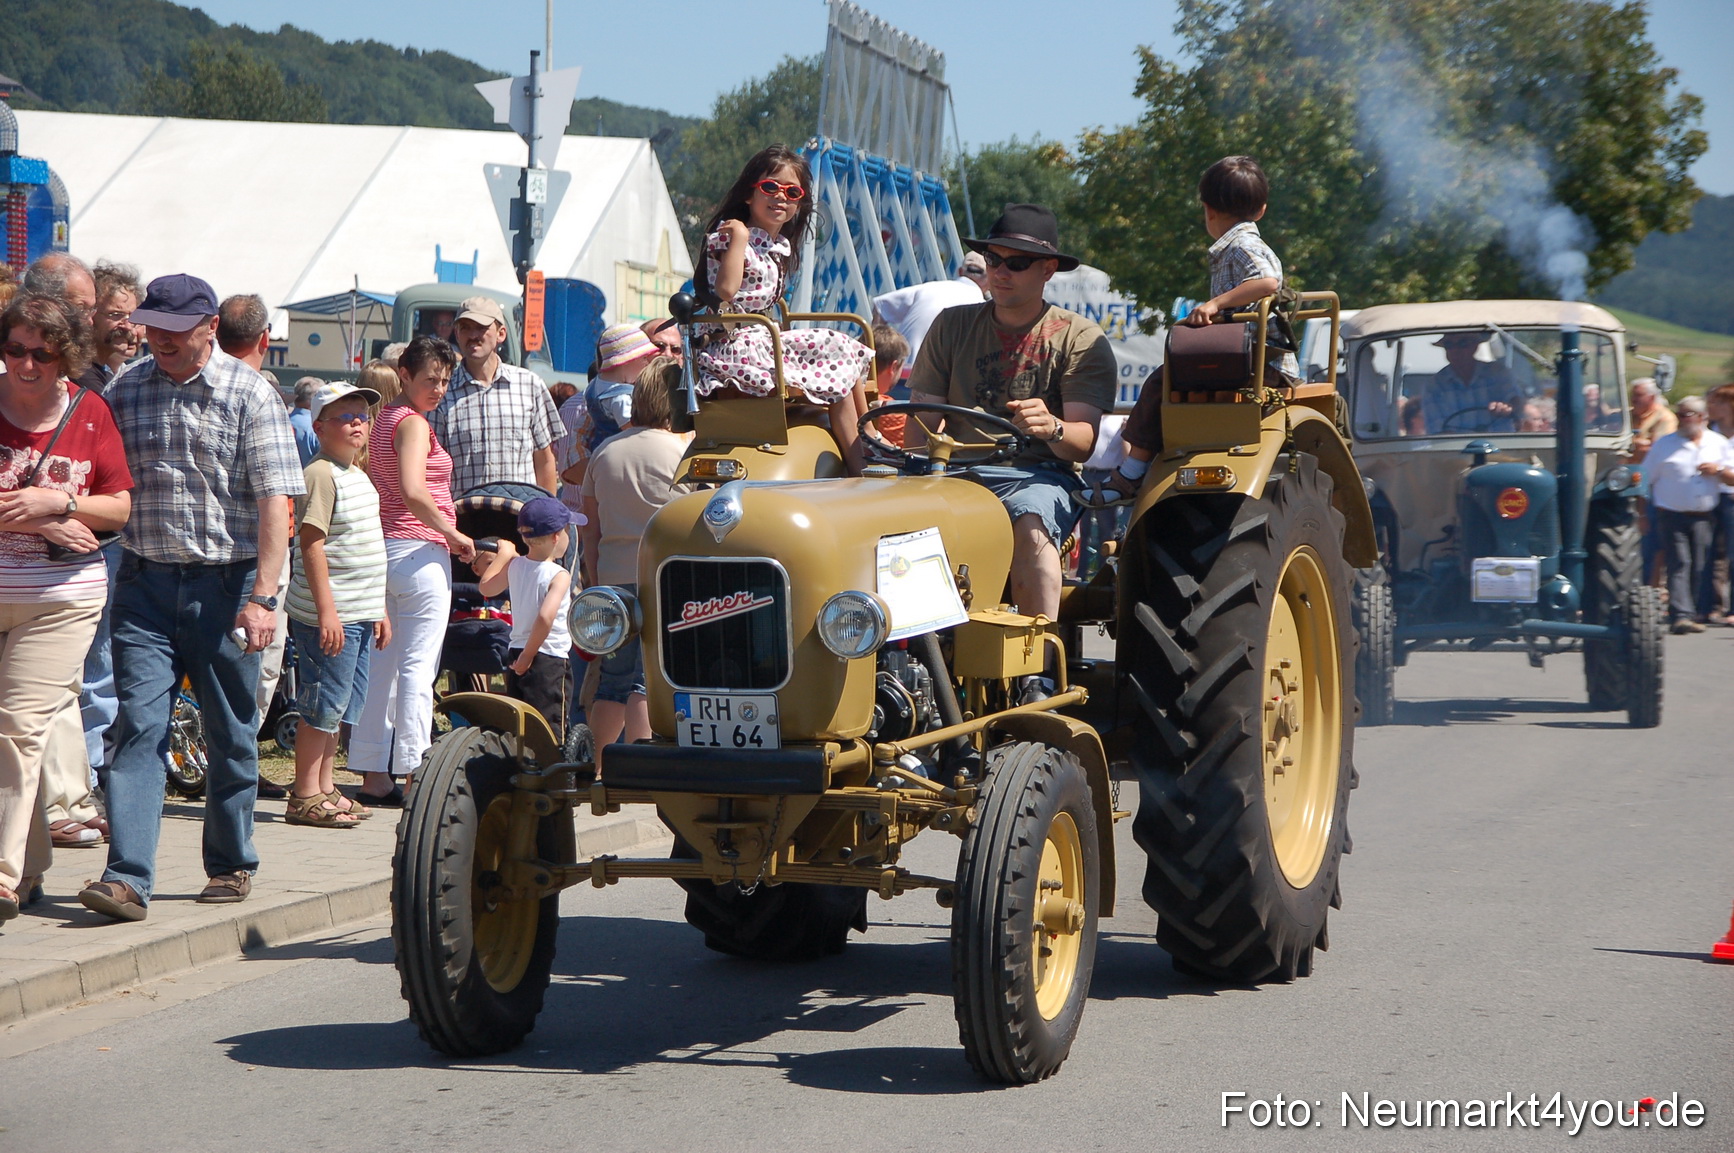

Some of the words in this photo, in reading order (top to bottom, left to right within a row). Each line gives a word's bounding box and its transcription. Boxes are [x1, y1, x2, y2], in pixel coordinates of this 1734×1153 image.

[683, 591, 753, 621] Eicher
[698, 697, 731, 721] RH
[690, 723, 721, 747] EI
[732, 724, 763, 748] 64
